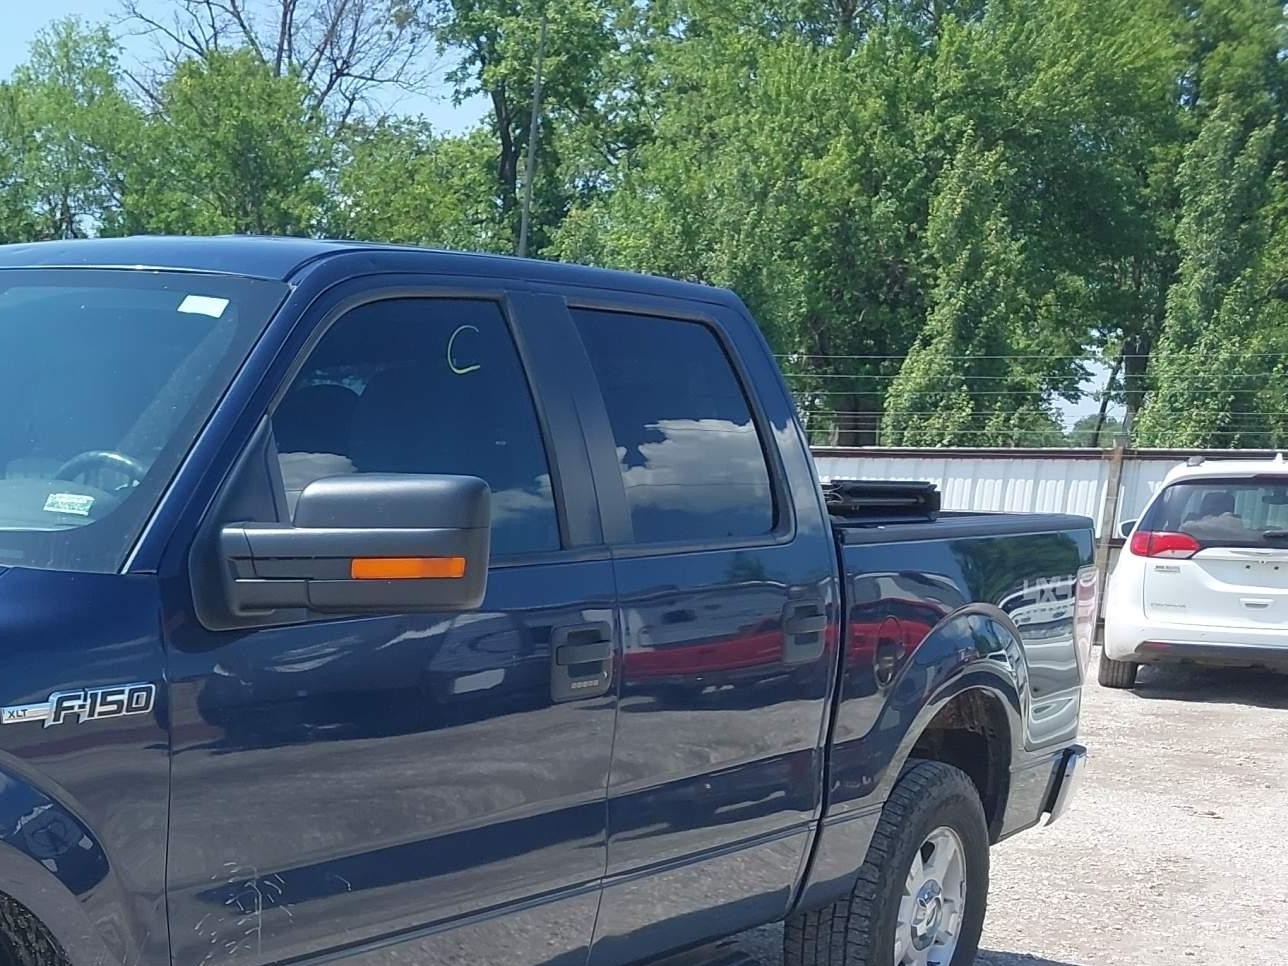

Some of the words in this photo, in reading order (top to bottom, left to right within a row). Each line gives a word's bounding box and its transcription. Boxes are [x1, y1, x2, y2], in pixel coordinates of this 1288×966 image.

[448, 325, 480, 373] C
[8, 708, 28, 719] XLT
[49, 684, 155, 725] F-150
